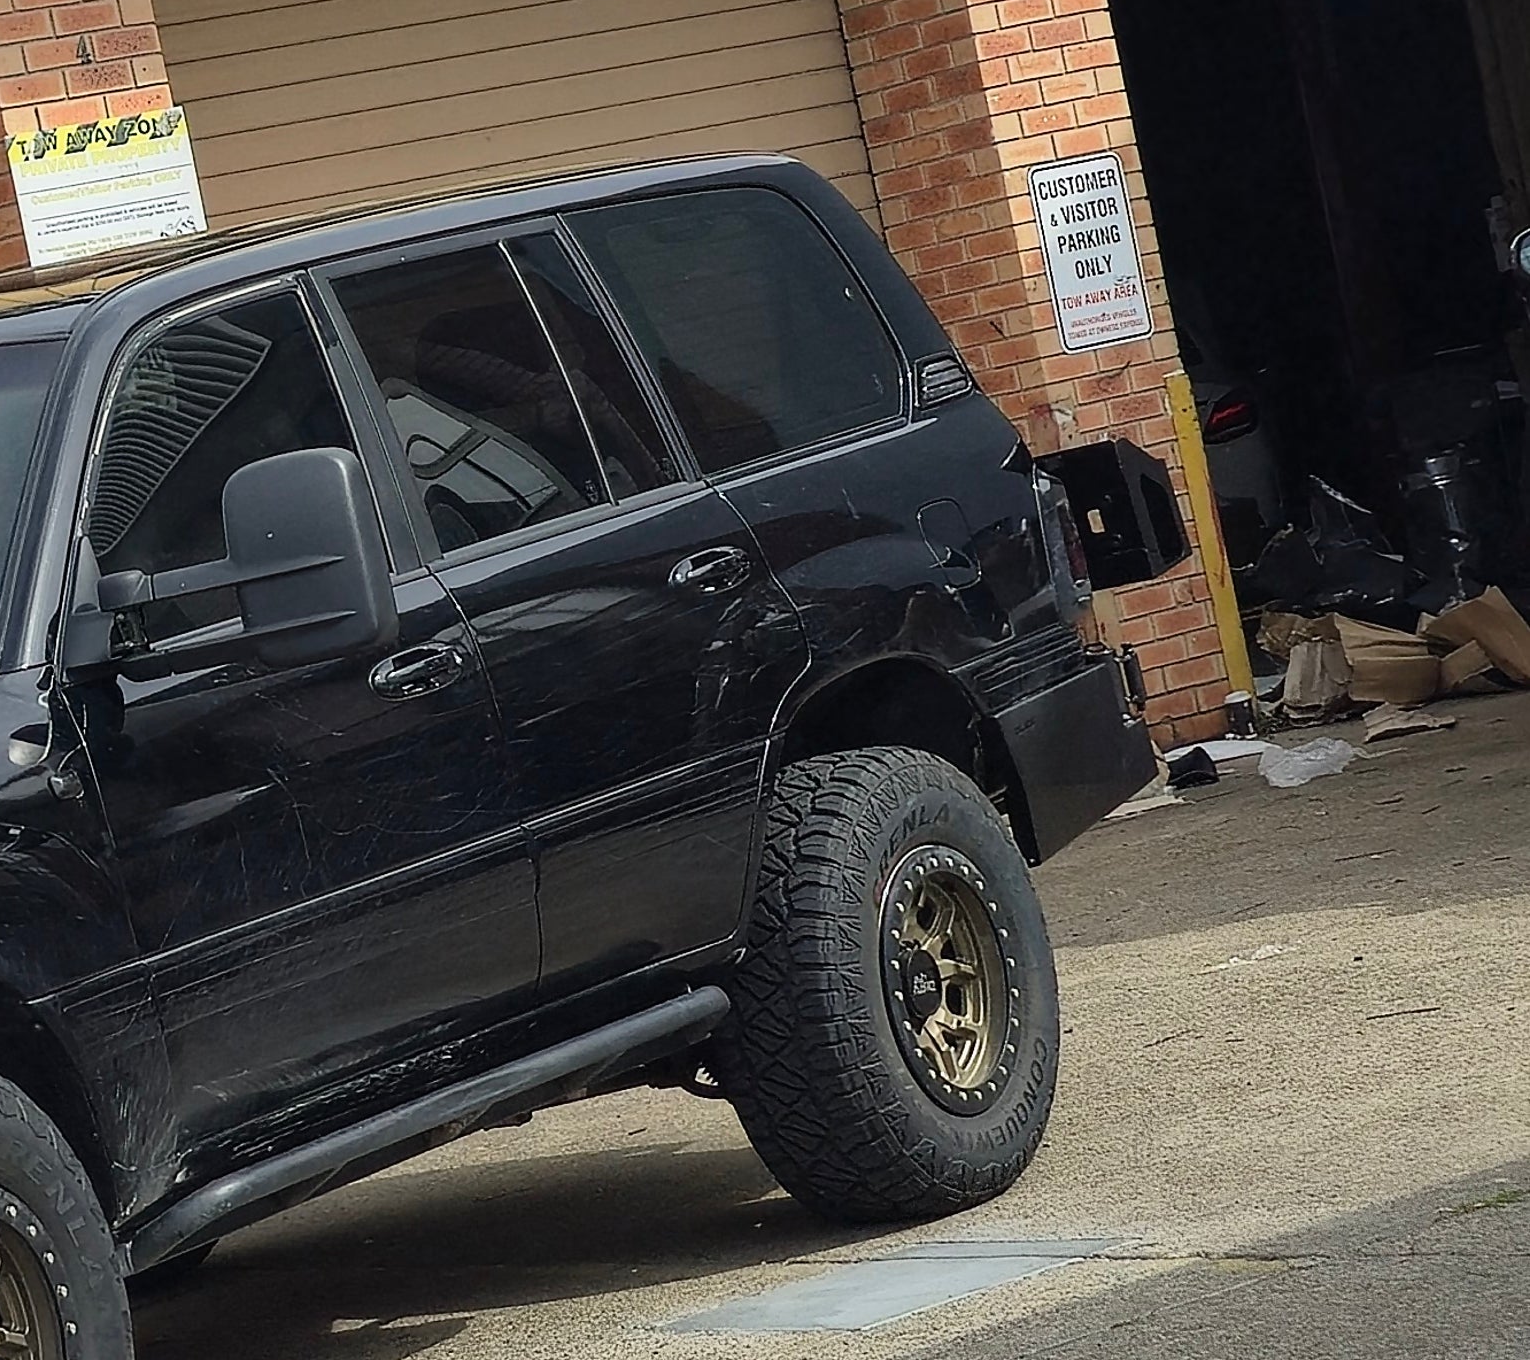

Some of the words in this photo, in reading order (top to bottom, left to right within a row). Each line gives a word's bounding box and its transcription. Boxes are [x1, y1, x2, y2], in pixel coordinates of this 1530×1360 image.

[16, 132, 58, 156] TOW
[66, 124, 118, 148] AWAY
[20, 151, 88, 178] PRIVATE
[92, 136, 182, 166] PROPERTY
[1038, 168, 1118, 200] CUSTOMER
[1050, 214, 1058, 226] &
[1060, 197, 1119, 224] VISITOR
[1058, 224, 1121, 254] PARKING
[1075, 254, 1113, 280] ONLY
[1062, 294, 1083, 310] TOW
[1085, 289, 1111, 305] AWAY
[1114, 283, 1138, 300] AREA
